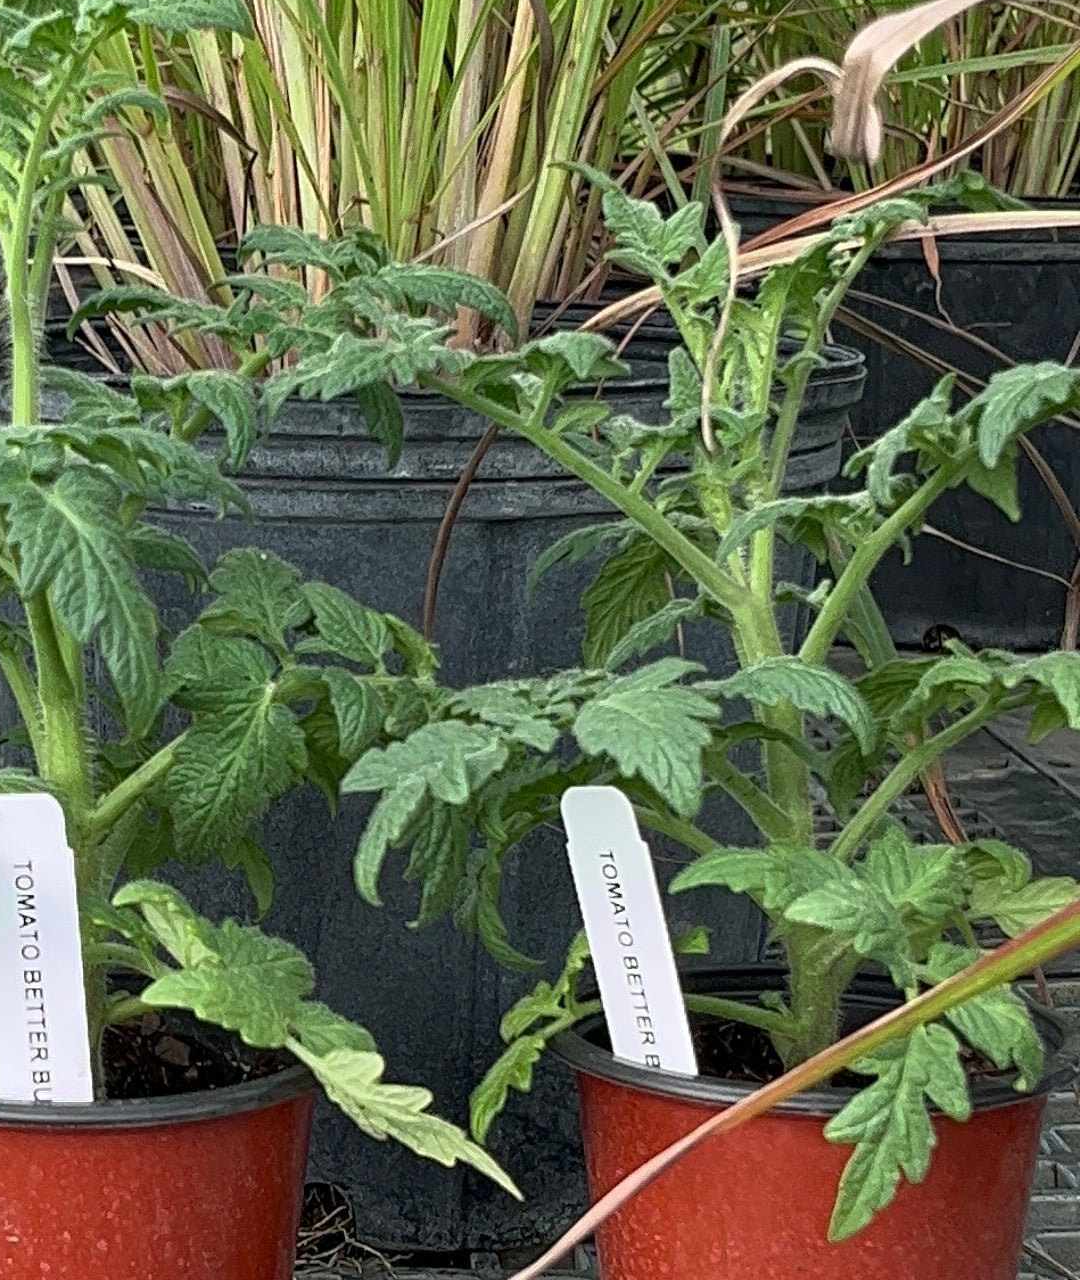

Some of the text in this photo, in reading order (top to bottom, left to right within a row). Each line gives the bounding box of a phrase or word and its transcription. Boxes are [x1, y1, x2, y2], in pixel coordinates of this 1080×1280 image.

[13, 860, 41, 961] TOMATO
[599, 850, 633, 948] TOMATO
[623, 956, 660, 1046] BETTER
[23, 970, 49, 1062] BETTER
